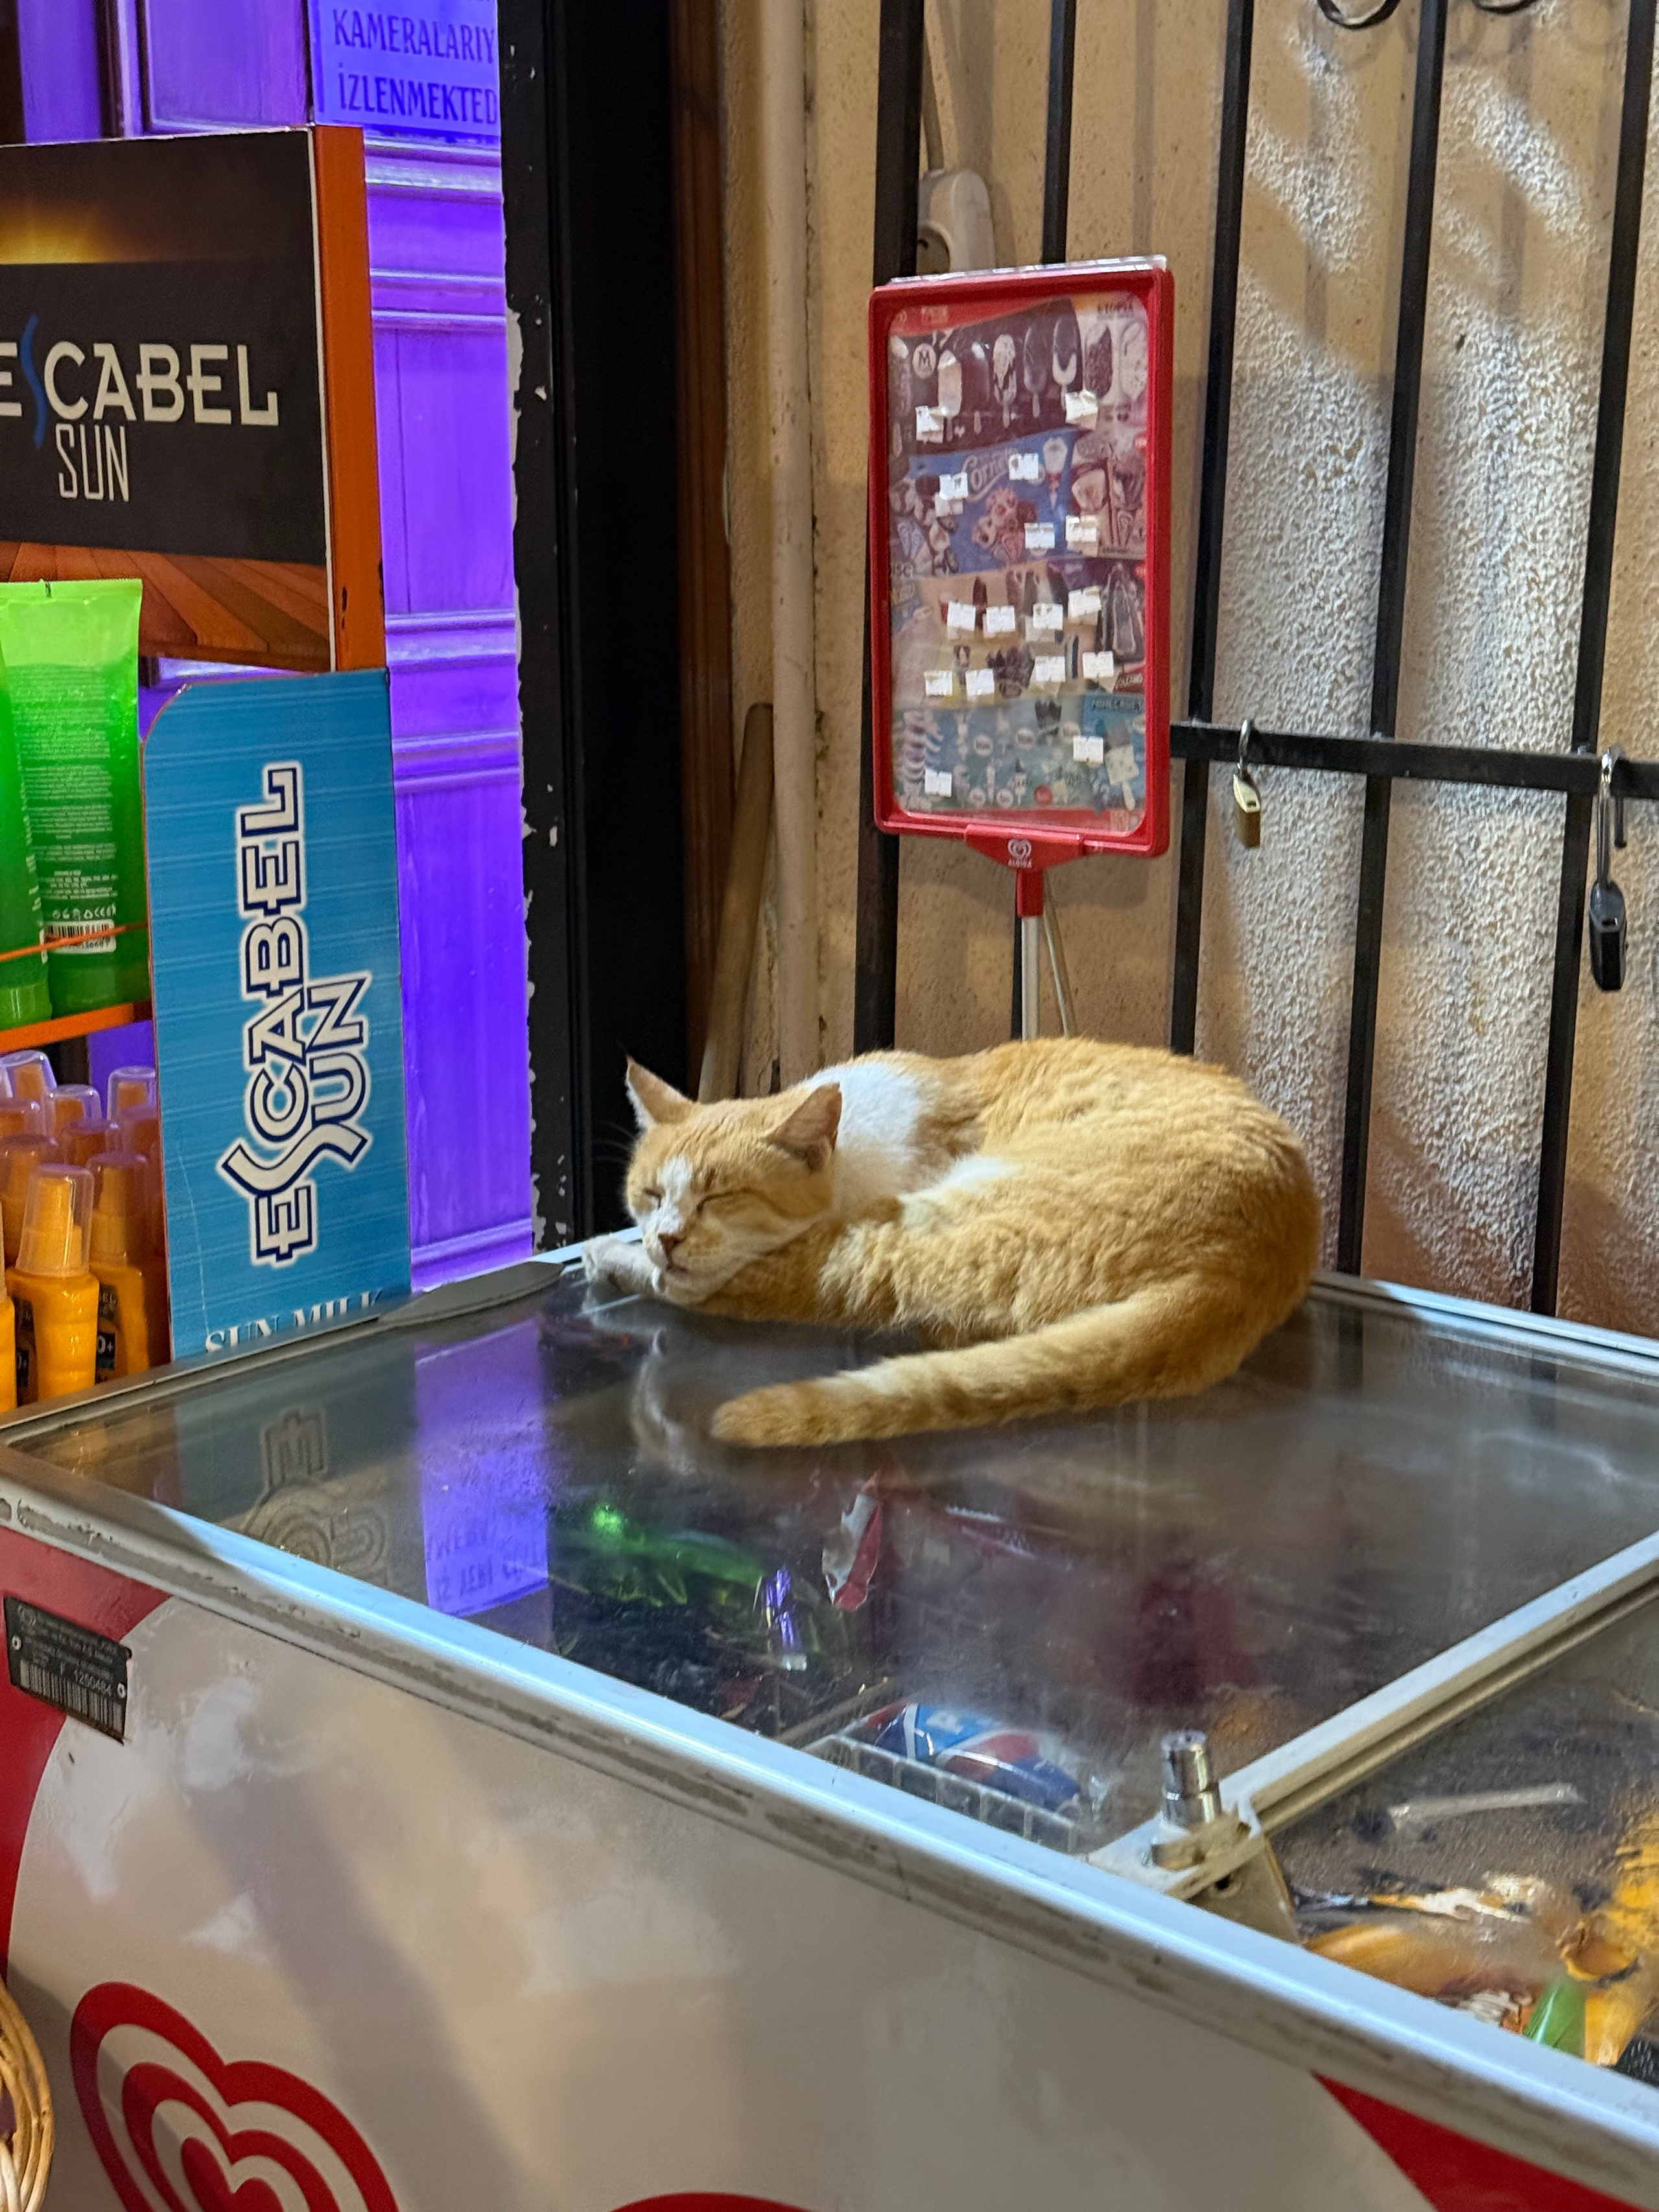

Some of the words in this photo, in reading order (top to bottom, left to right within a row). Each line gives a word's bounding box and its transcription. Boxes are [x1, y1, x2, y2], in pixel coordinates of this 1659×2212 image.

[333, 8, 495, 64] KAMERALARIY
[338, 62, 497, 124] İZLENMEKTED
[56, 423, 129, 502] SUN
[220, 765, 368, 1263] ESCABEL
